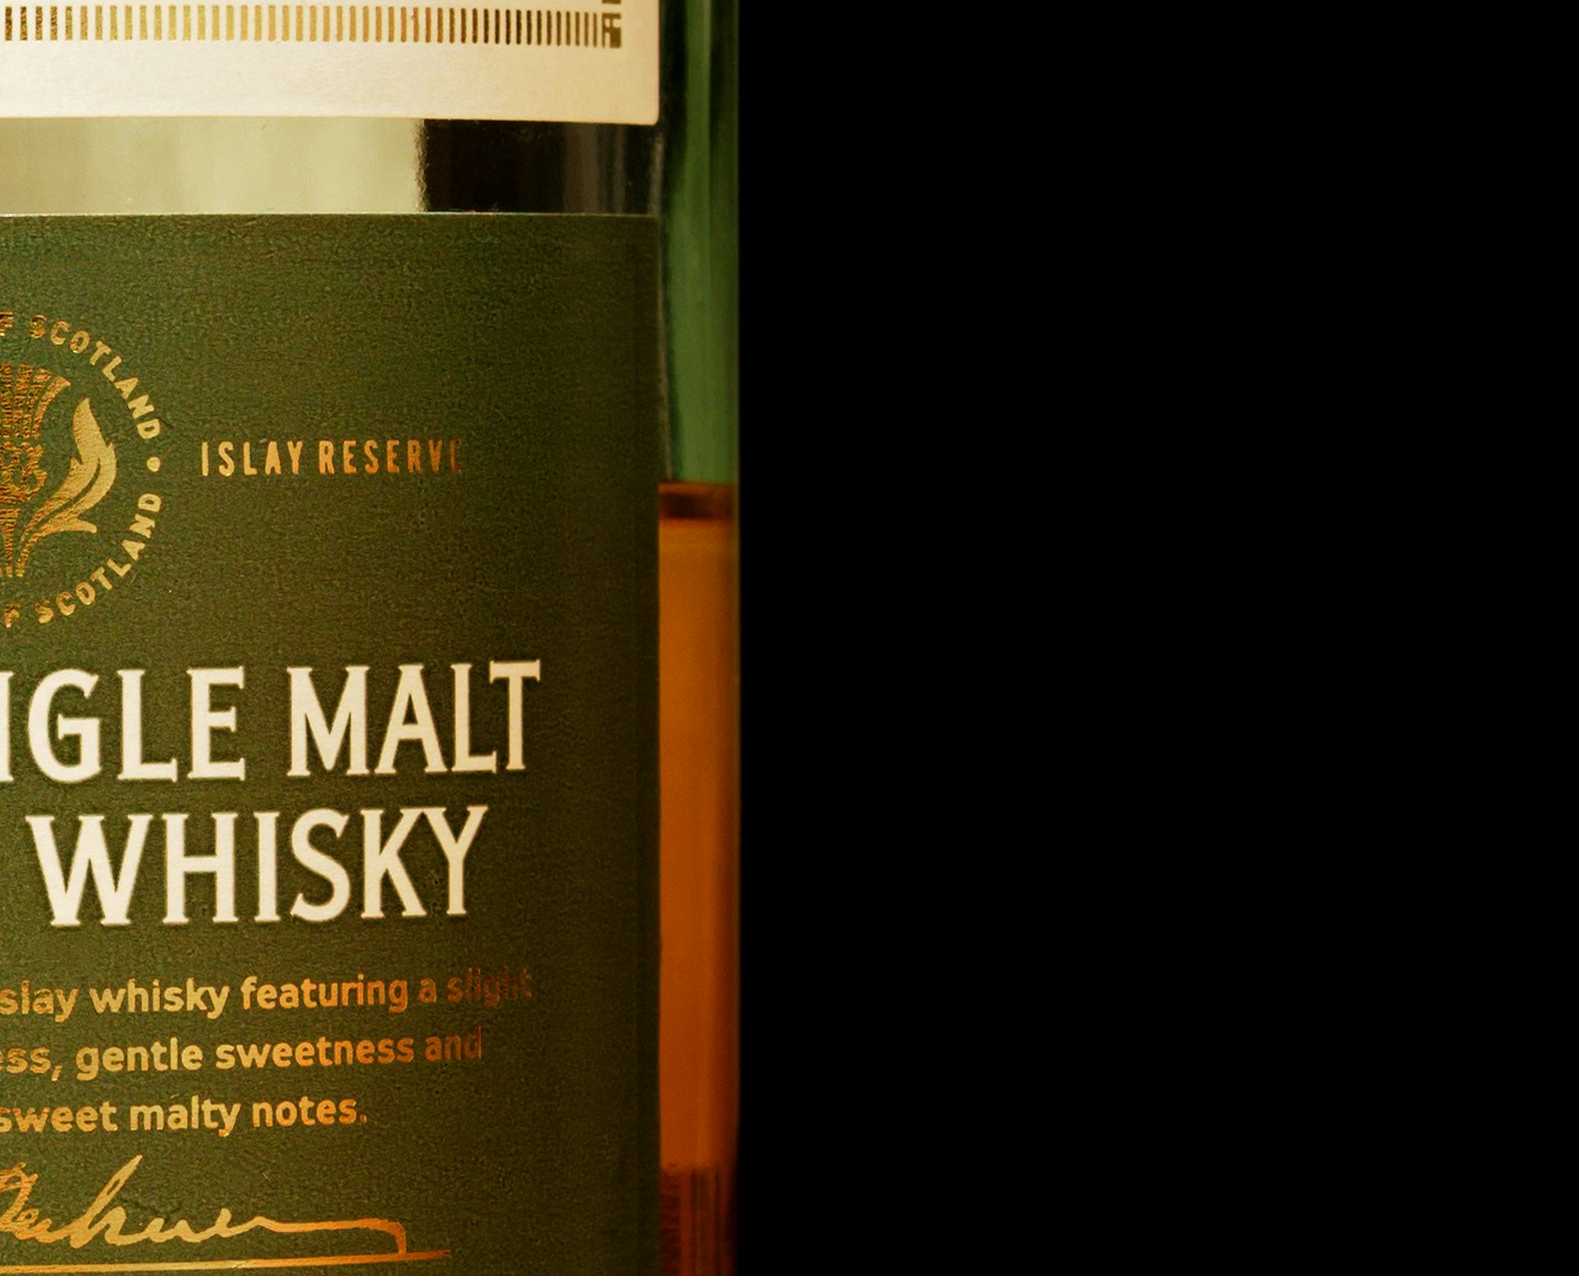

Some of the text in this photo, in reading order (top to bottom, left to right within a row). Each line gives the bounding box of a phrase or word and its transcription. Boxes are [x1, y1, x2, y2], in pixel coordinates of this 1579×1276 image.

[29, 314, 162, 440] SCOTLAND
[201, 437, 462, 476] ISLAY RESERVE
[34, 492, 163, 624] SCOTLAND
[285, 658, 542, 778] MALT
[26, 804, 490, 928] WHISKY
[90, 976, 231, 1020] whisky
[241, 972, 409, 1013] featuring
[418, 976, 439, 1004] a
[446, 966, 534, 1008] slight
[75, 1036, 203, 1082] gentle
[215, 1035, 415, 1071] sweetness
[424, 1025, 484, 1061] and
[129, 1094, 242, 1138] malty
[251, 1095, 368, 1128] notes.
